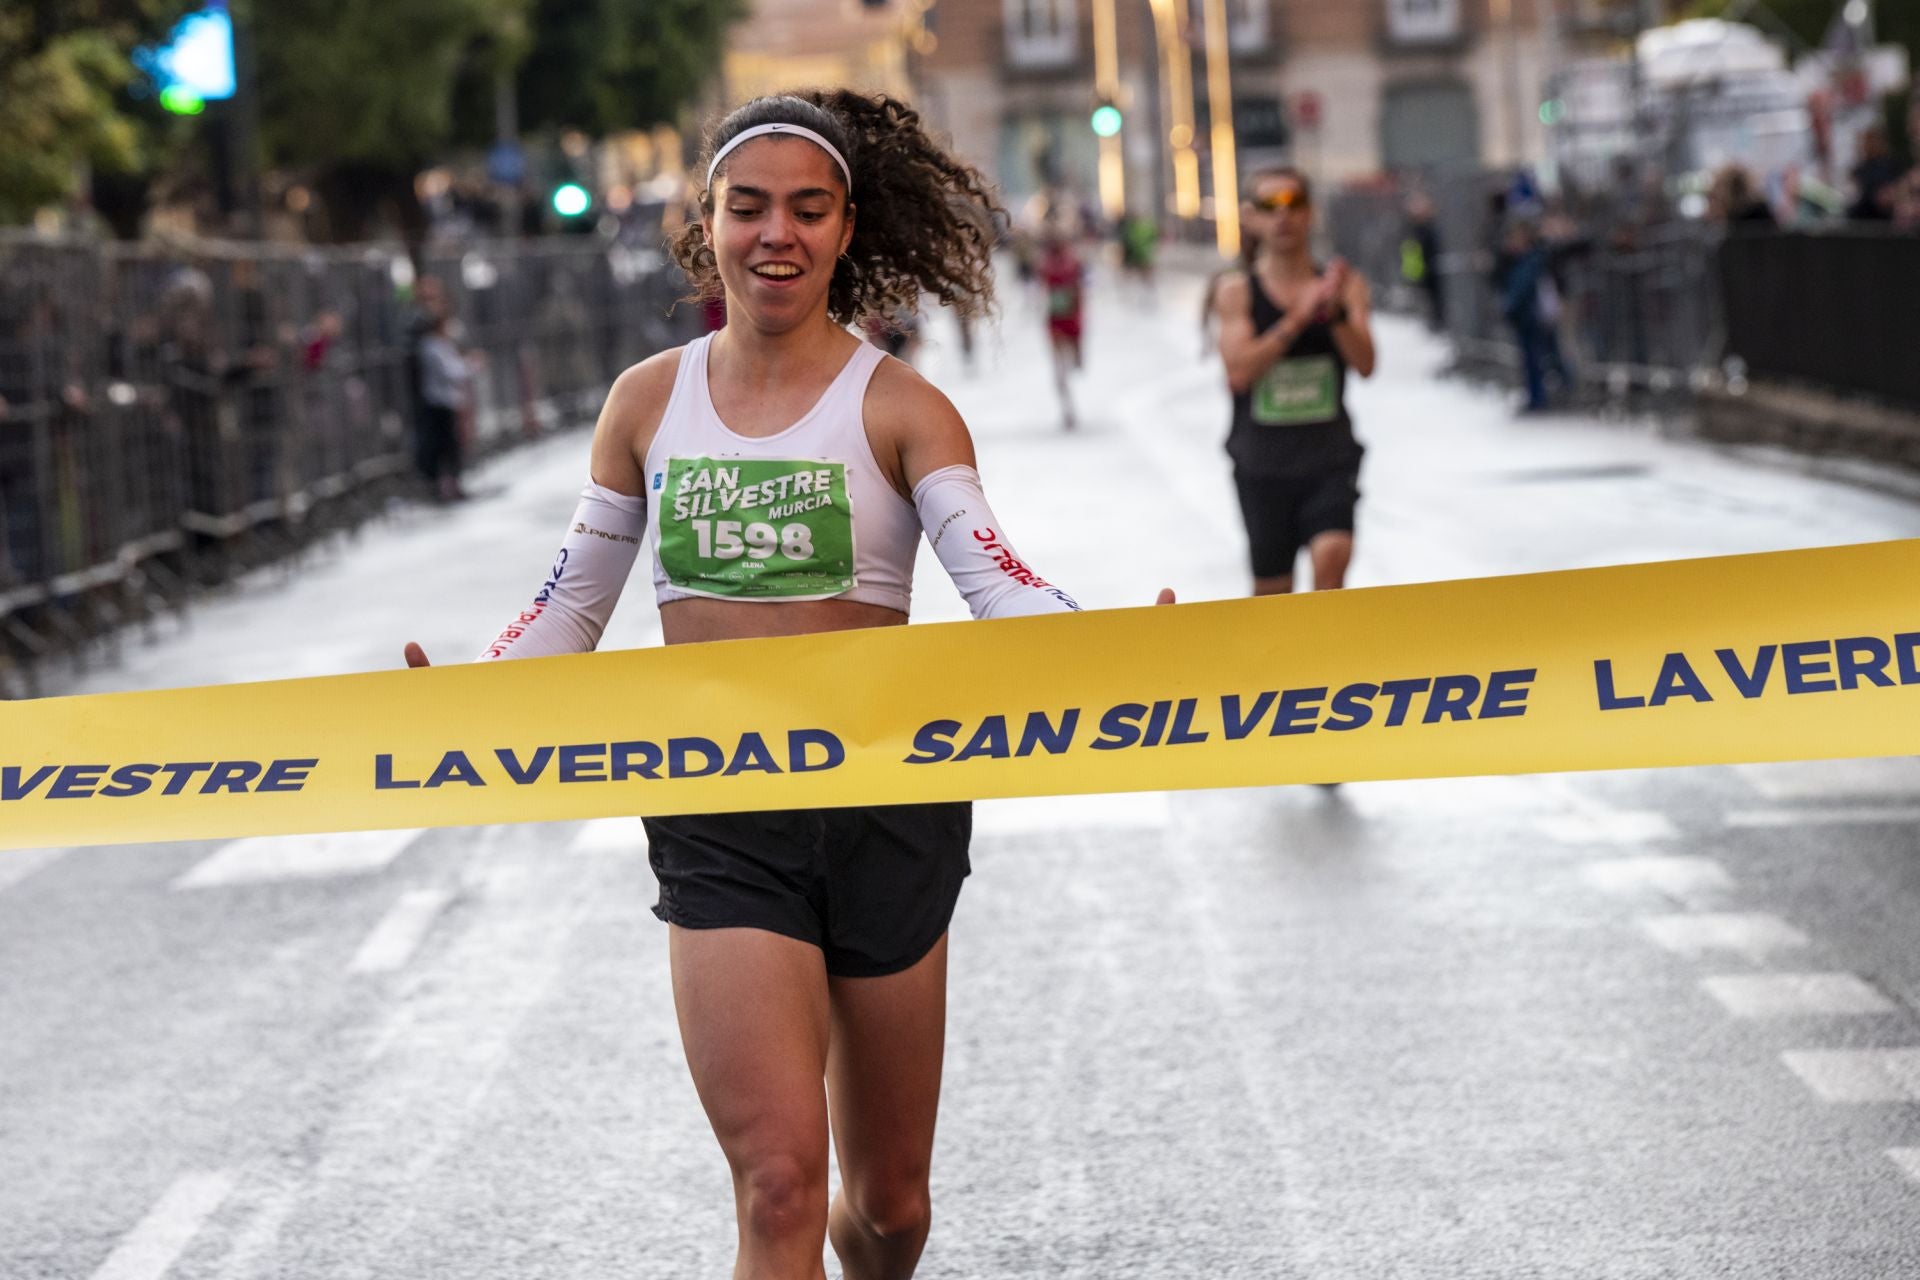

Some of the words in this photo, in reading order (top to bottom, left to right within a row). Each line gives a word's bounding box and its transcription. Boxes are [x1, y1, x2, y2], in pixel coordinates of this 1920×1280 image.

[673, 469, 832, 521] SILVESTRE
[676, 467, 740, 496] SAN
[768, 495, 833, 520] MURCIA
[691, 519, 815, 561] 1598
[741, 561, 765, 569] ELENA
[1593, 652, 1714, 711] LA
[903, 708, 1080, 764] SAN
[1089, 668, 1538, 750] SILVESTRE
[1, 759, 317, 801] VESTRE
[375, 751, 485, 789] LA
[495, 729, 846, 784] VERDAD
